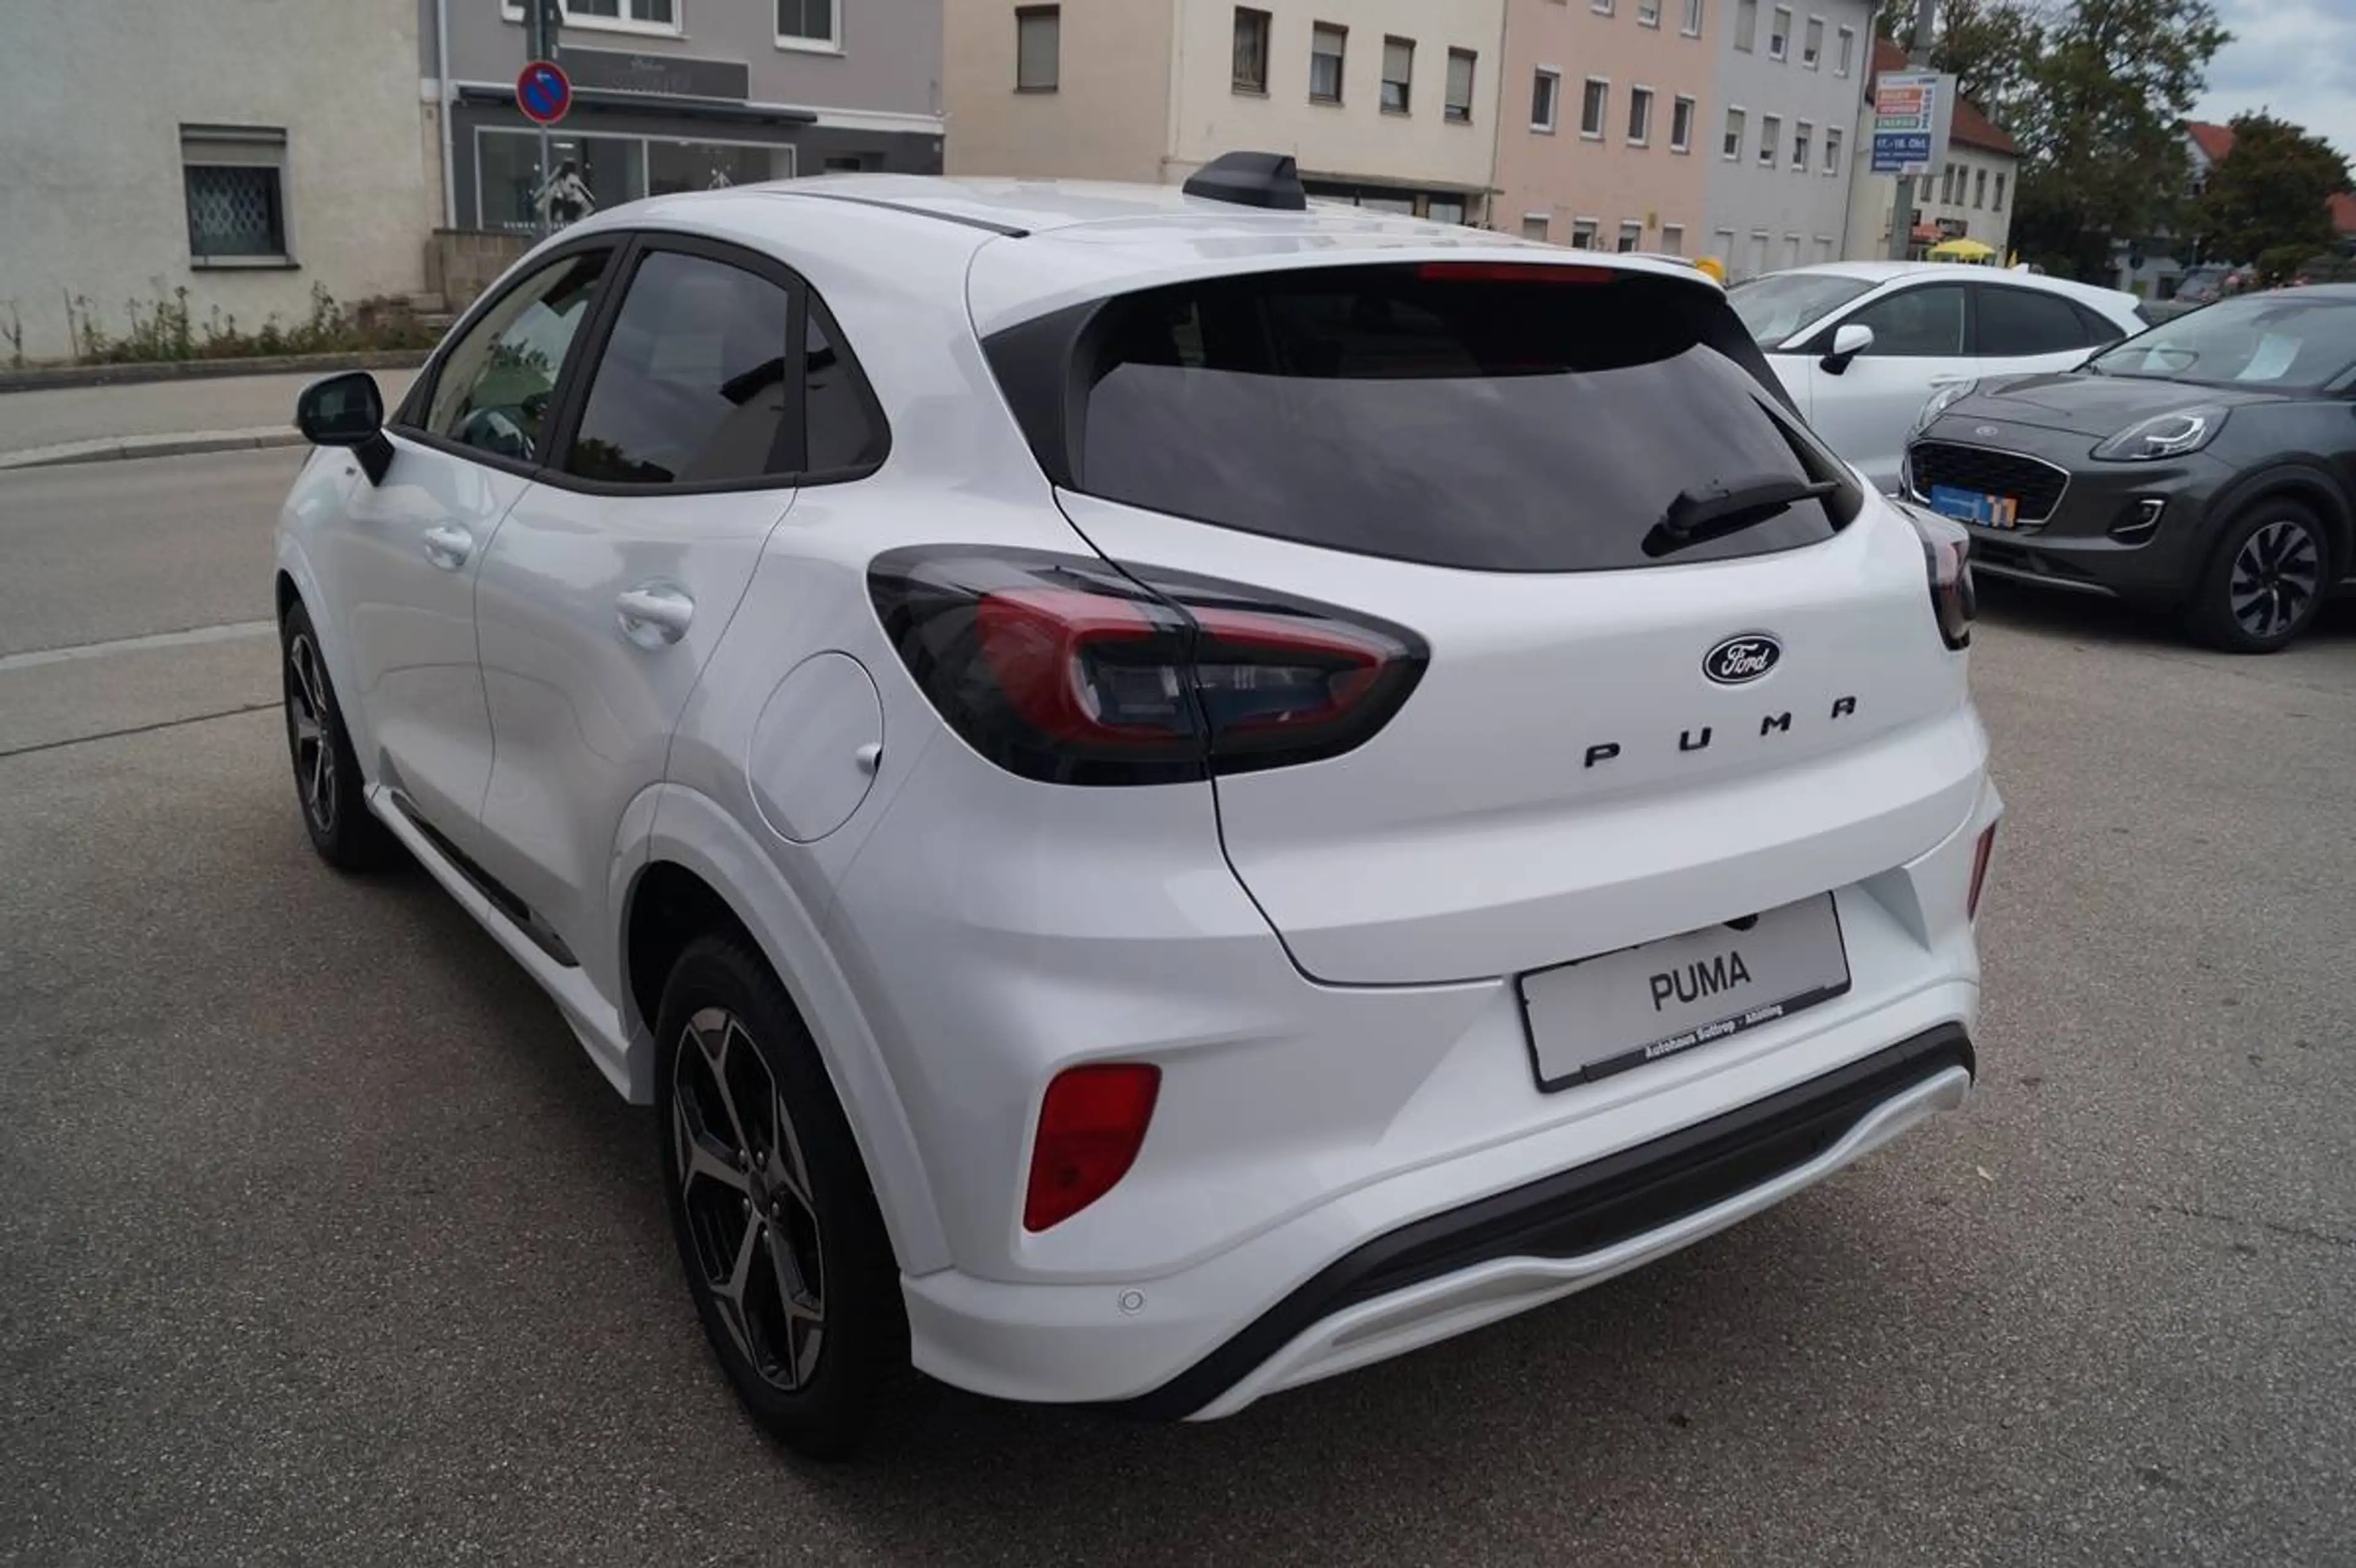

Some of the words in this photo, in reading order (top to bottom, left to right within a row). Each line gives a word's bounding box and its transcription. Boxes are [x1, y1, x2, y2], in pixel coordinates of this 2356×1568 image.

[1721, 643, 1770, 675] Ford
[1584, 696, 1857, 769] PUMA
[1649, 950, 1752, 1012] PUMA
